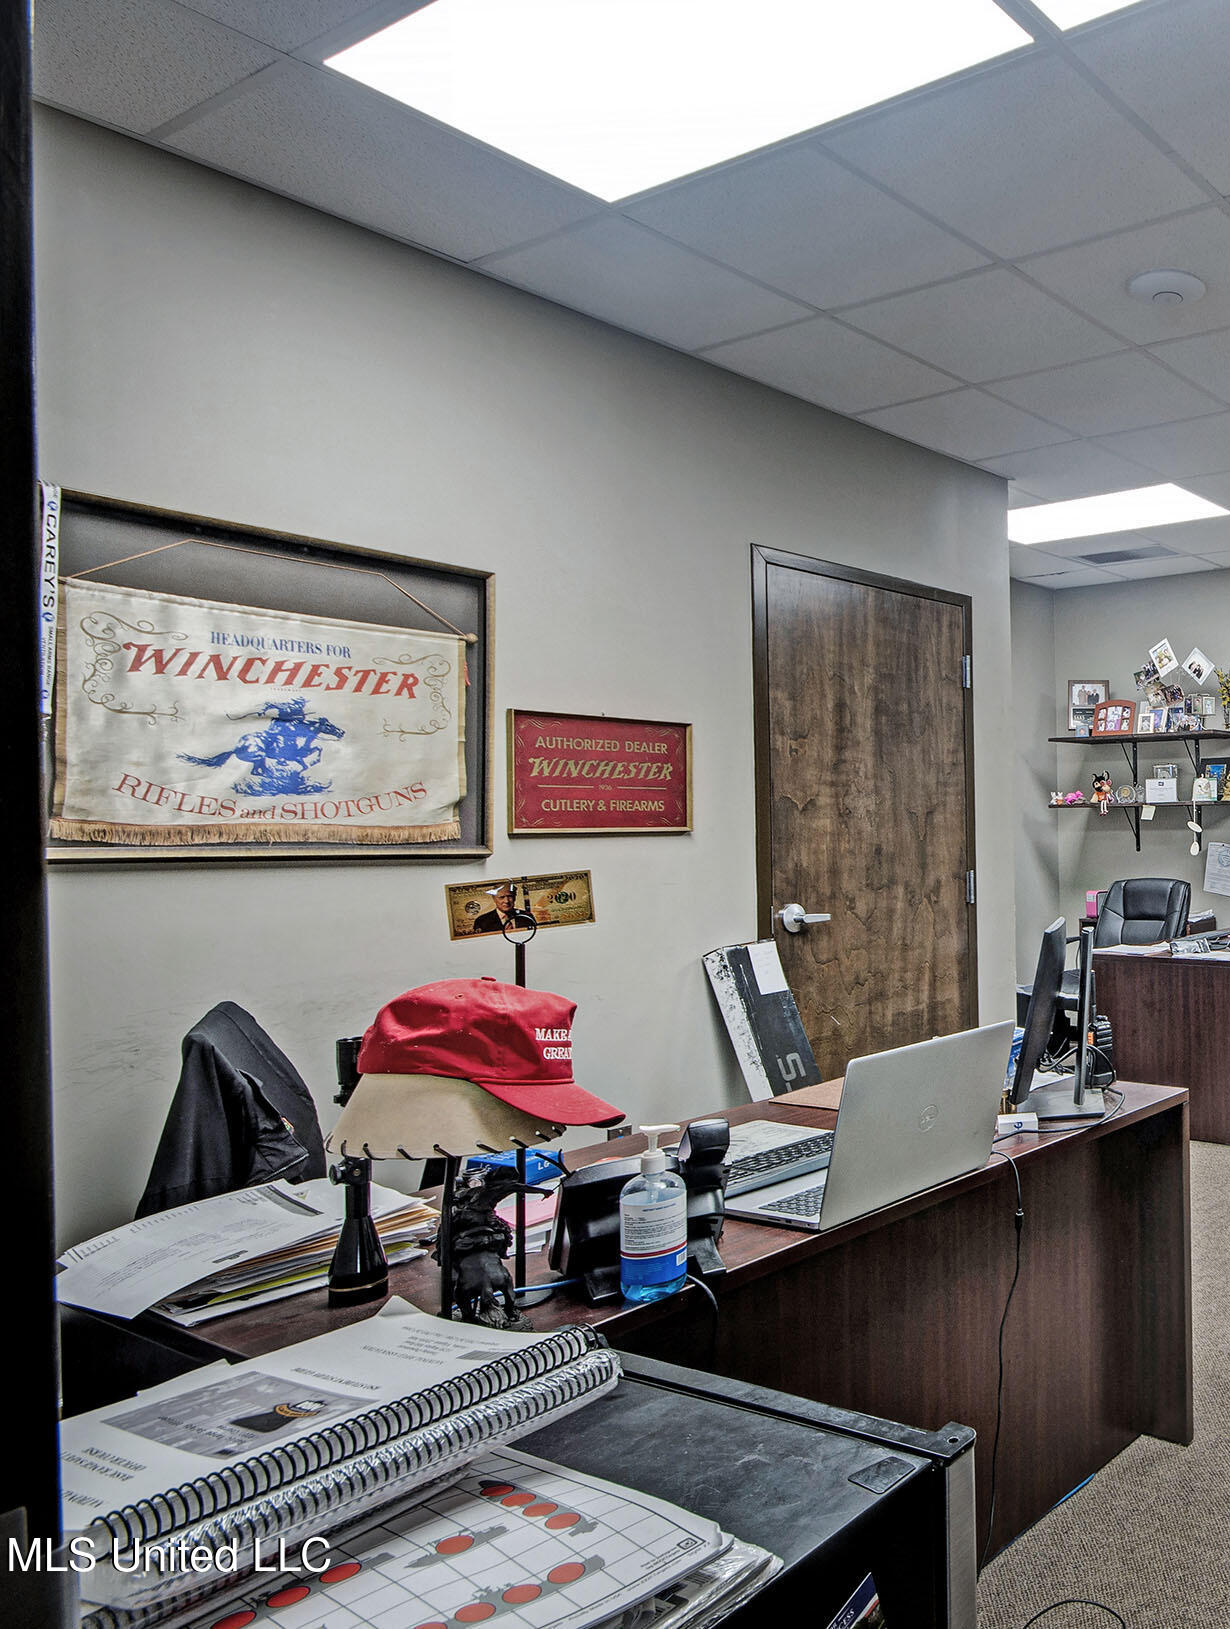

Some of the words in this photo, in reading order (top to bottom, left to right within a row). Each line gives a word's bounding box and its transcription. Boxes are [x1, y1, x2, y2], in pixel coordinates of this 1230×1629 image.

[43, 514, 57, 607] CAREY'S
[210, 632, 322, 655] HEADQUARTERS
[326, 644, 351, 659] FOR
[122, 642, 419, 699] WINCHESTER
[535, 736, 620, 752] AUTHORIZED
[625, 741, 668, 754] DEALER
[528, 756, 673, 781] WINCHESTER
[112, 772, 237, 818] RIFLES
[239, 805, 276, 821] and
[280, 780, 428, 820] SHOTGUNS
[541, 800, 595, 812] CUTLERY
[597, 800, 607, 811] &
[610, 800, 665, 812] FIREARMS
[535, 1028, 567, 1041] MAKE
[537, 1160, 550, 1171] LG
